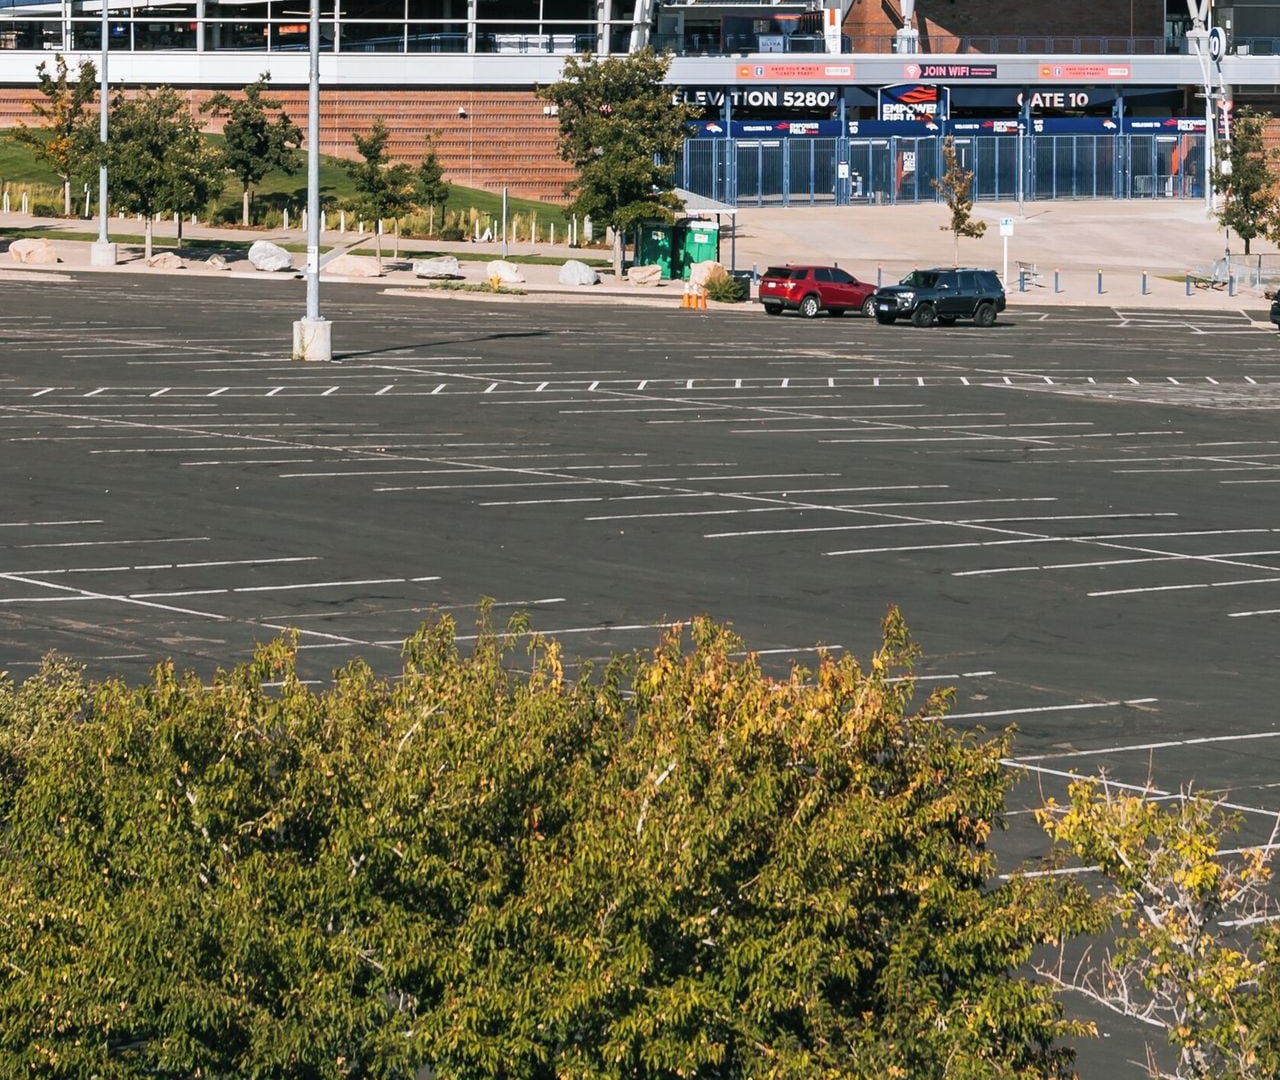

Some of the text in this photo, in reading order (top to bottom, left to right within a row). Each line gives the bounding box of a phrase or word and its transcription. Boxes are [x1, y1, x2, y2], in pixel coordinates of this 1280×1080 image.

[924, 66, 946, 76] JOIN
[948, 66, 970, 76] WIFI
[1069, 93, 1089, 107] 10
[849, 126, 858, 134] 10
